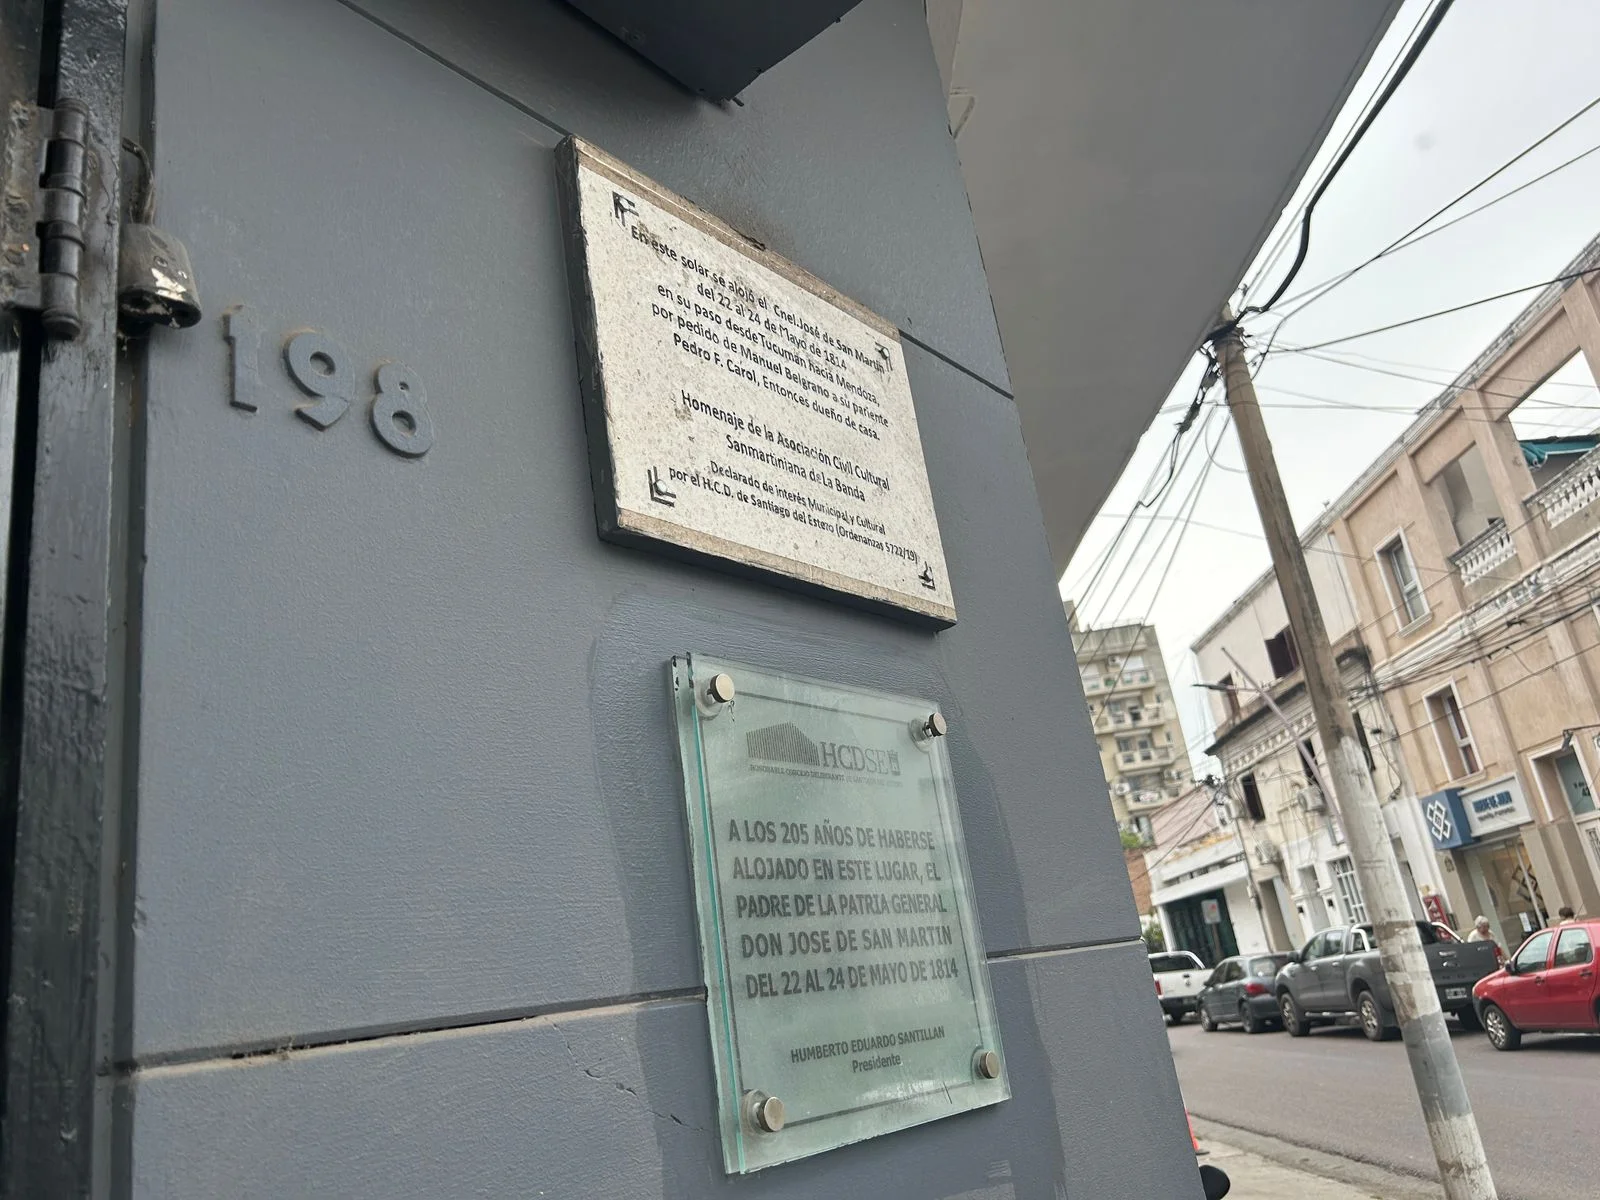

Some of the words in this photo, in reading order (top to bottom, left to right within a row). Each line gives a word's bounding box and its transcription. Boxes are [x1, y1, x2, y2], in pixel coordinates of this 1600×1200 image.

[631, 225, 648, 245] En
[651, 239, 678, 261] este
[681, 255, 709, 278] solar
[713, 272, 726, 288] se
[728, 280, 755, 303] alojó
[758, 297, 767, 310] el
[822, 332, 834, 347] de
[837, 340, 853, 355] San
[697, 283, 715, 301] del
[717, 292, 733, 311] 22
[735, 304, 745, 317] al
[748, 309, 760, 325] 24
[764, 318, 777, 333] de
[780, 325, 806, 349] Mayo
[810, 343, 821, 357] de
[824, 350, 847, 370] 1814
[222, 304, 435, 459] 198
[651, 303, 673, 322] por
[677, 315, 720, 344] pedido
[723, 336, 737, 353] de
[740, 344, 783, 375] Manuel
[784, 367, 830, 399] Belgrano
[833, 393, 838, 402] a
[840, 395, 850, 409] su
[853, 402, 889, 428] pariente
[657, 284, 673, 301] en
[677, 294, 690, 309] su
[694, 303, 722, 325] paso
[725, 317, 758, 344] desde
[808, 359, 834, 383] hacia
[835, 374, 880, 407] Mendoza,
[673, 333, 711, 361] Pedro
[714, 352, 723, 367] F.
[727, 359, 760, 387] Carol,
[762, 375, 810, 408] Entonces
[812, 400, 843, 423] dueño
[845, 416, 857, 431] de
[859, 424, 880, 440] casa.
[681, 390, 744, 430] Homenaje
[747, 420, 762, 437] de
[763, 424, 774, 442] la
[777, 432, 832, 467] Asociación
[832, 455, 853, 475] Civil
[855, 465, 890, 491] Cultural
[726, 434, 807, 480] Sanmartiniana
[821, 472, 833, 489] La
[835, 478, 866, 502] Banda
[668, 467, 688, 481] por
[690, 474, 701, 488] el
[702, 476, 734, 498] H.C.D.
[736, 490, 748, 503] de
[750, 494, 790, 519] Santiago
[792, 510, 807, 525] del
[808, 514, 835, 533] Estero
[835, 523, 884, 552] (Ordenanzas
[710, 460, 760, 489] Declarado
[762, 481, 774, 494] de
[776, 485, 806, 507] interés
[807, 497, 849, 525] Municipal
[856, 515, 886, 535] Cultural
[728, 820, 741, 842] A
[744, 821, 776, 843] LOS
[780, 822, 809, 844] 205
[814, 818, 854, 846] AÑOS
[856, 827, 876, 848] DE
[877, 828, 935, 850] HABERSE
[733, 857, 809, 880] ALOJADO
[813, 859, 834, 880] EN
[837, 860, 873, 881] ESTE
[876, 861, 923, 885] LUGAR,
[926, 863, 941, 881] EL
[736, 895, 792, 918] PADRE
[794, 894, 816, 917] DE
[818, 894, 837, 916] LA
[839, 894, 890, 915] PATRIA
[891, 893, 947, 914] GENERAL
[741, 933, 783, 958] DON
[788, 931, 832, 955] JOSE
[836, 929, 858, 952] DE
[861, 928, 893, 950] SAN
[896, 925, 953, 948] MARTIN
[746, 973, 778, 999] DEL
[781, 971, 802, 996] 22
[806, 969, 824, 993] AL
[827, 967, 845, 990] 24
[848, 965, 867, 988] DE
[869, 962, 907, 986] MAYO
[909, 960, 927, 982] DE
[929, 958, 958, 980] 1814
[791, 1041, 849, 1064] HUMBERTO
[851, 1033, 896, 1053] EDUARDO
[897, 1026, 945, 1046] SANTILLAN
[852, 1053, 901, 1073] Presidente
